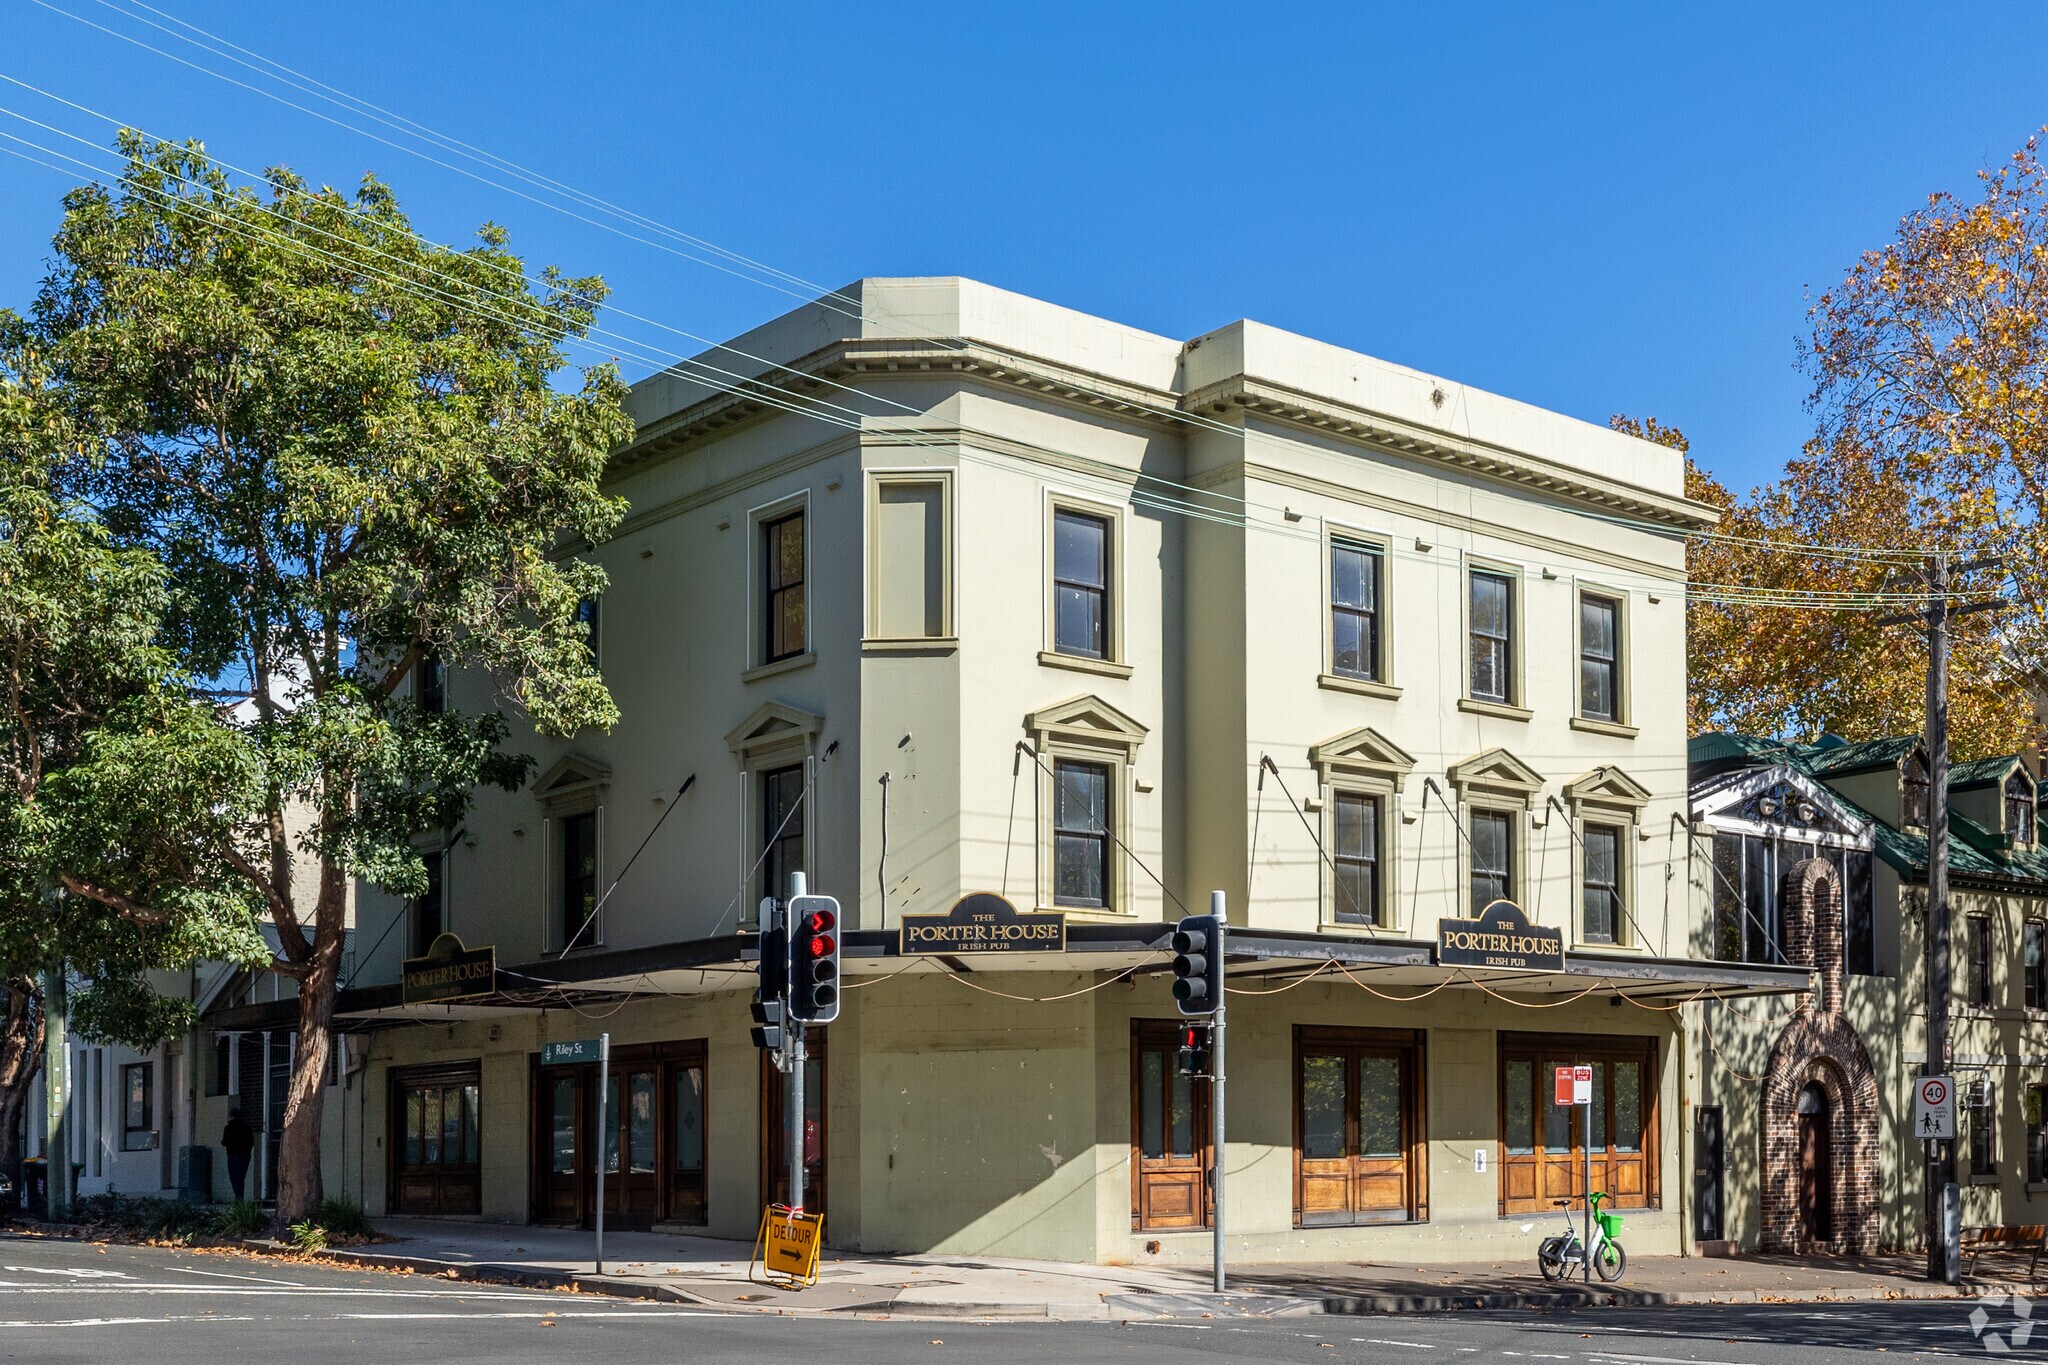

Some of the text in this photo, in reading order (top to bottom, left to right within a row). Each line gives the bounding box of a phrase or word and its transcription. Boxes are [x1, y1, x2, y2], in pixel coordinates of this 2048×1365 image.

[972, 914, 995, 922] THE
[1497, 921, 1515, 931] THE
[957, 942, 1010, 951] IRISH PUB
[1485, 956, 1526, 967] IRISH PUB
[556, 1043, 582, 1057] Riley St
[1926, 1087, 1942, 1098] 40
[774, 1224, 810, 1244] DETOUR
